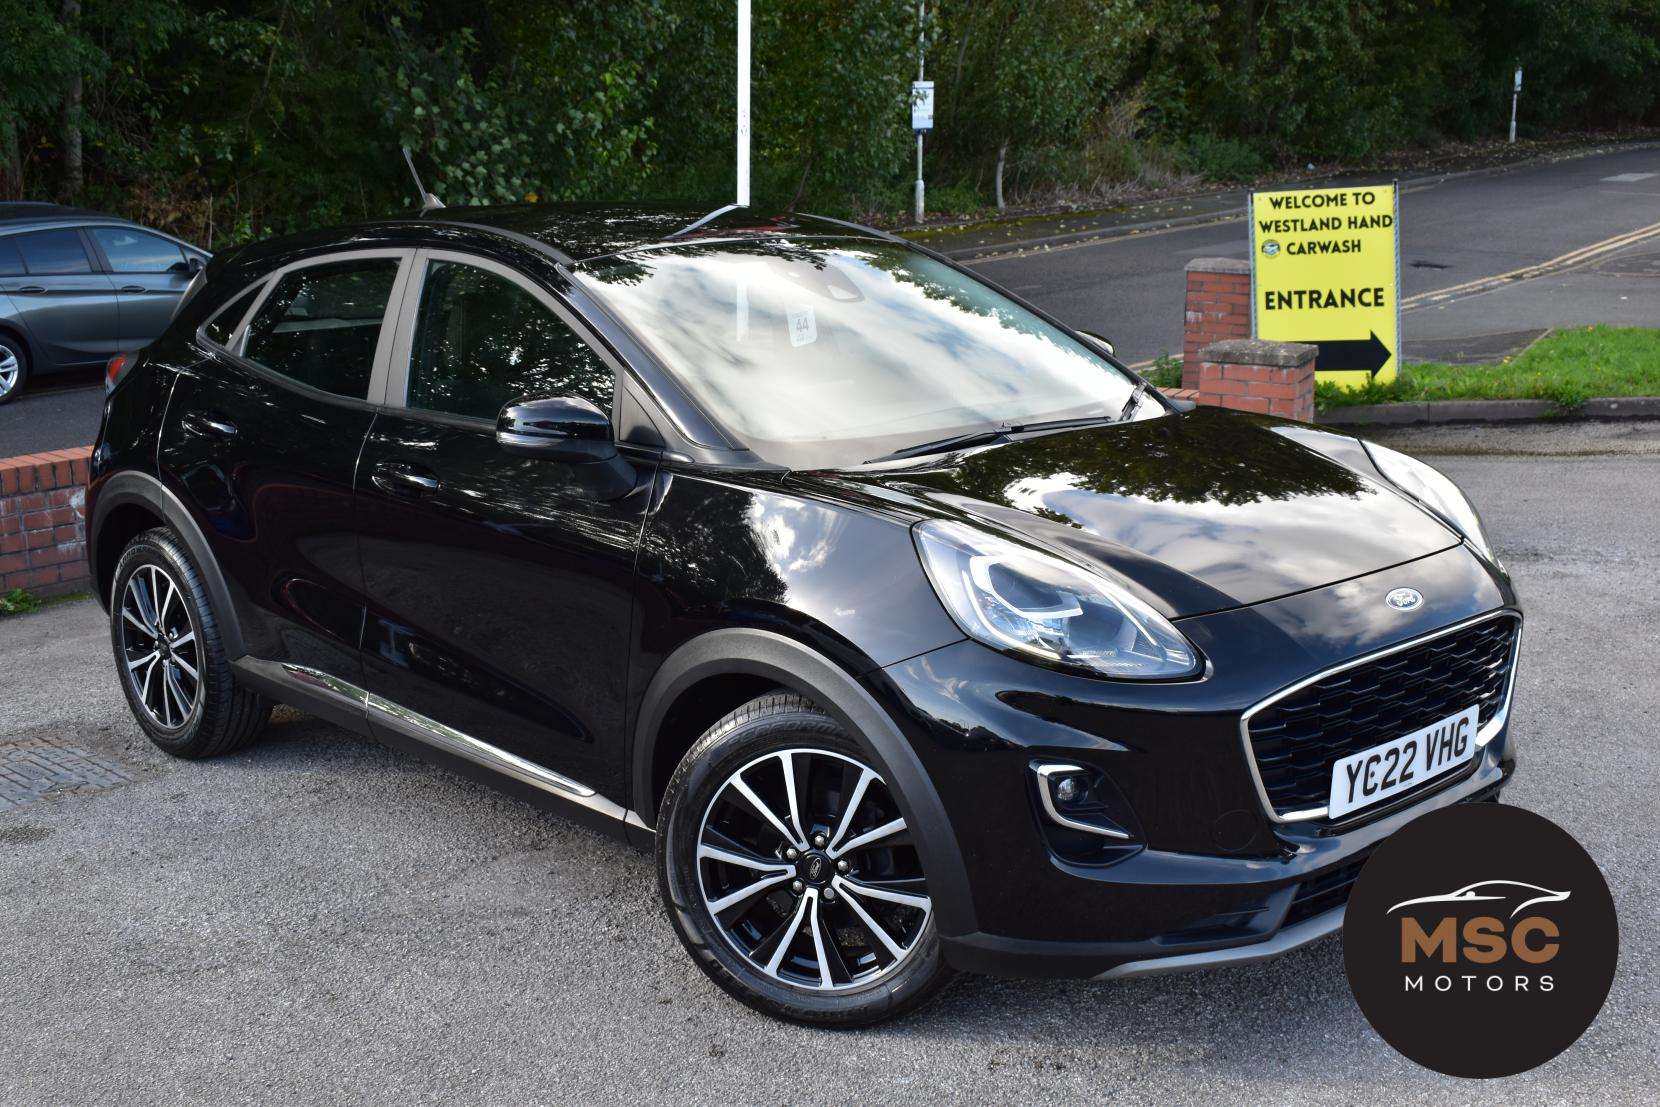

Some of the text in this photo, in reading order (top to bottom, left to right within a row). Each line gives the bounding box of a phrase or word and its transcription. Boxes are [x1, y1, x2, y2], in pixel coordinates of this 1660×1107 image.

[1269, 192, 1375, 209] WELCOME TO
[1259, 215, 1392, 233] WESTLAND HAND
[1286, 240, 1361, 255] CARWASH
[1265, 288, 1385, 310] ENTRANCE
[1346, 717, 1469, 804] YC22 VHG
